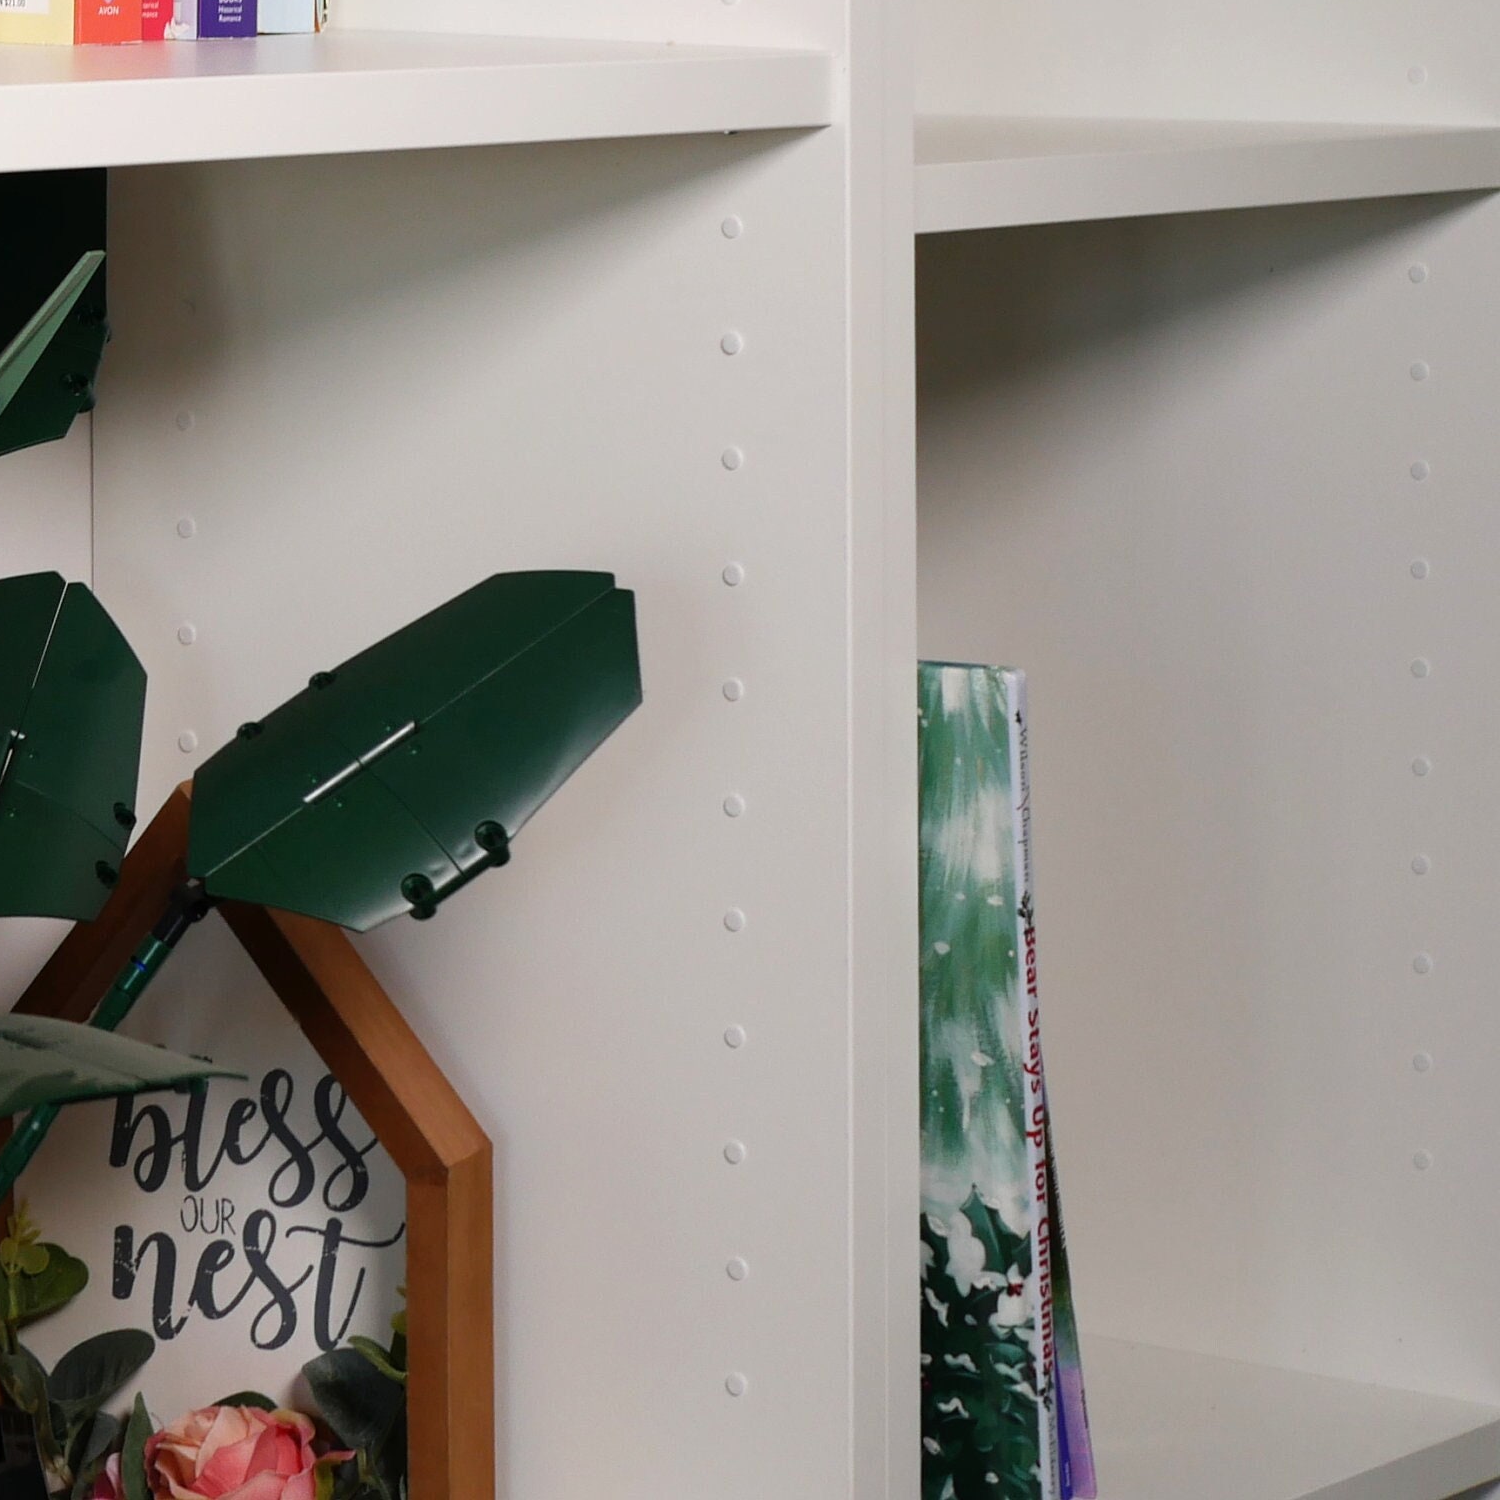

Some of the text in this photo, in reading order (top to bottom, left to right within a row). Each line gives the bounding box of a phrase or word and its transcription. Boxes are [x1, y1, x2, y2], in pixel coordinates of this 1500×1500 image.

[98, 4, 120, 15] AVON
[1022, 926, 1037, 999] Bear
[1023, 1008, 1043, 1095] Stays
[109, 1068, 378, 1212] bless
[1025, 1103, 1045, 1148] Up
[180, 1195, 237, 1237] OUR
[1034, 1158, 1047, 1203] for
[112, 1208, 405, 1352] nest
[1037, 1216, 1055, 1373] Christmas
